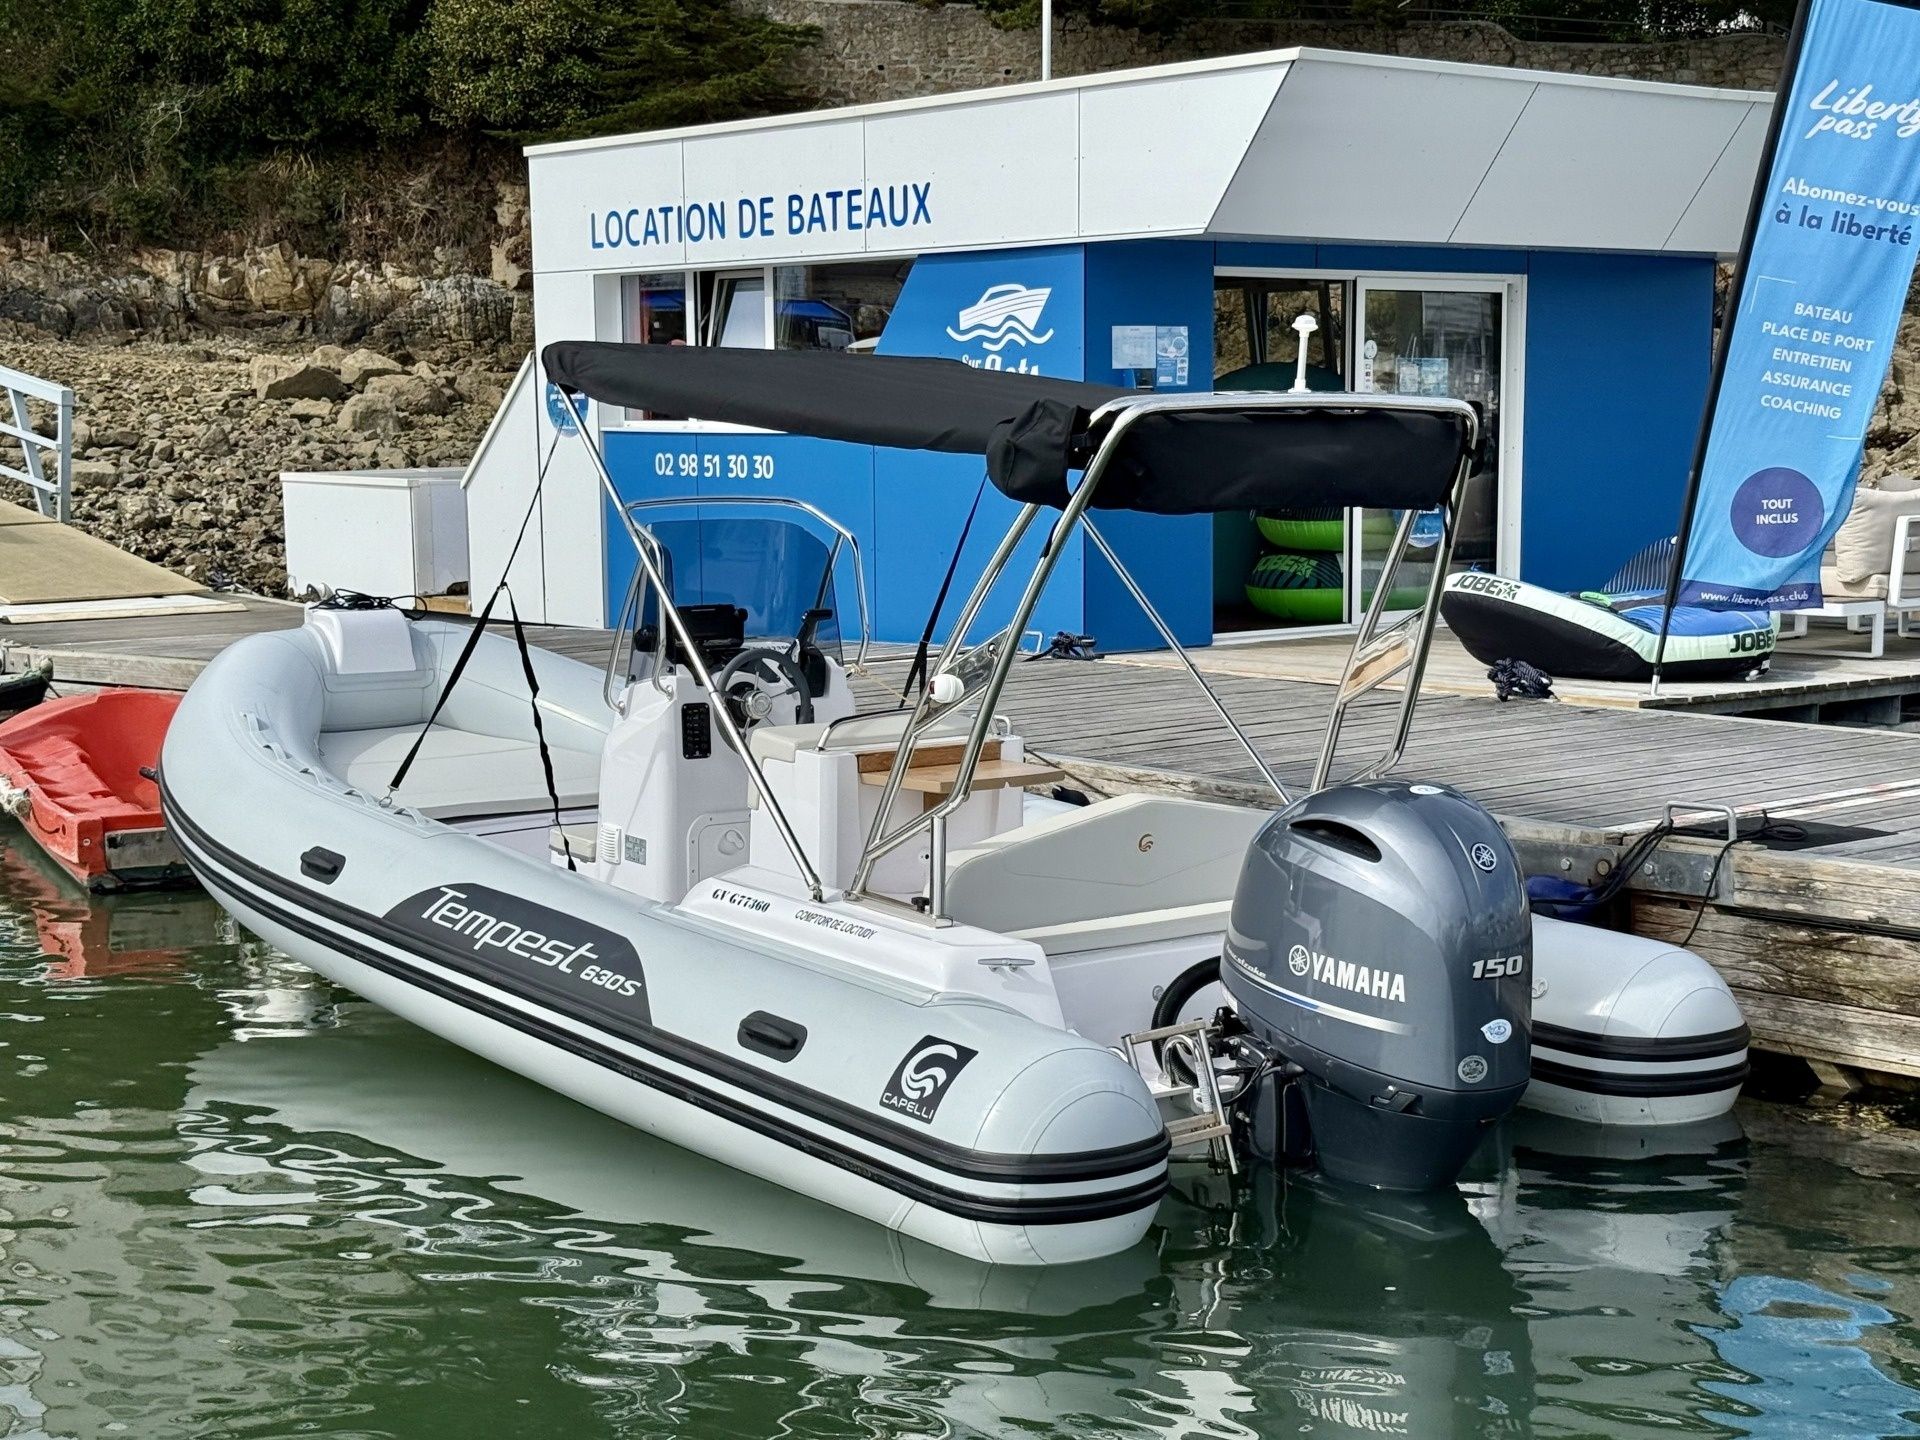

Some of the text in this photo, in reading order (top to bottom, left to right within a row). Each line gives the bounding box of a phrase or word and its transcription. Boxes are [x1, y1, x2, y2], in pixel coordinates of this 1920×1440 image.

[1809, 78, 1920, 138] Liberty
[1804, 114, 1878, 140] pass
[1781, 177, 1920, 216] Abonnez-vous
[590, 181, 932, 250] LOCATION DE BATEAUX
[1774, 202, 1913, 246] à la liberté
[1793, 302, 1853, 324] BATEAU
[1762, 321, 1875, 352] PLACE DE PORT
[1772, 347, 1852, 374] ENTRETIEN
[1761, 370, 1853, 398] ASSURANCE
[1760, 394, 1842, 420] COACHING
[654, 452, 774, 480] 02 98 51 30 30
[1761, 498, 1793, 510] TOUT
[1755, 512, 1799, 525] INCLUS
[1451, 574, 1503, 596] JOBE
[712, 888, 771, 913] GV G77360
[420, 886, 642, 997] Tempest 630S
[829, 918, 844, 931] DE
[840, 922, 878, 940] LOCTUDY
[1312, 951, 1407, 1003] YAMAHA
[1471, 954, 1524, 980] 150
[882, 1093, 934, 1119] CAPELLI
